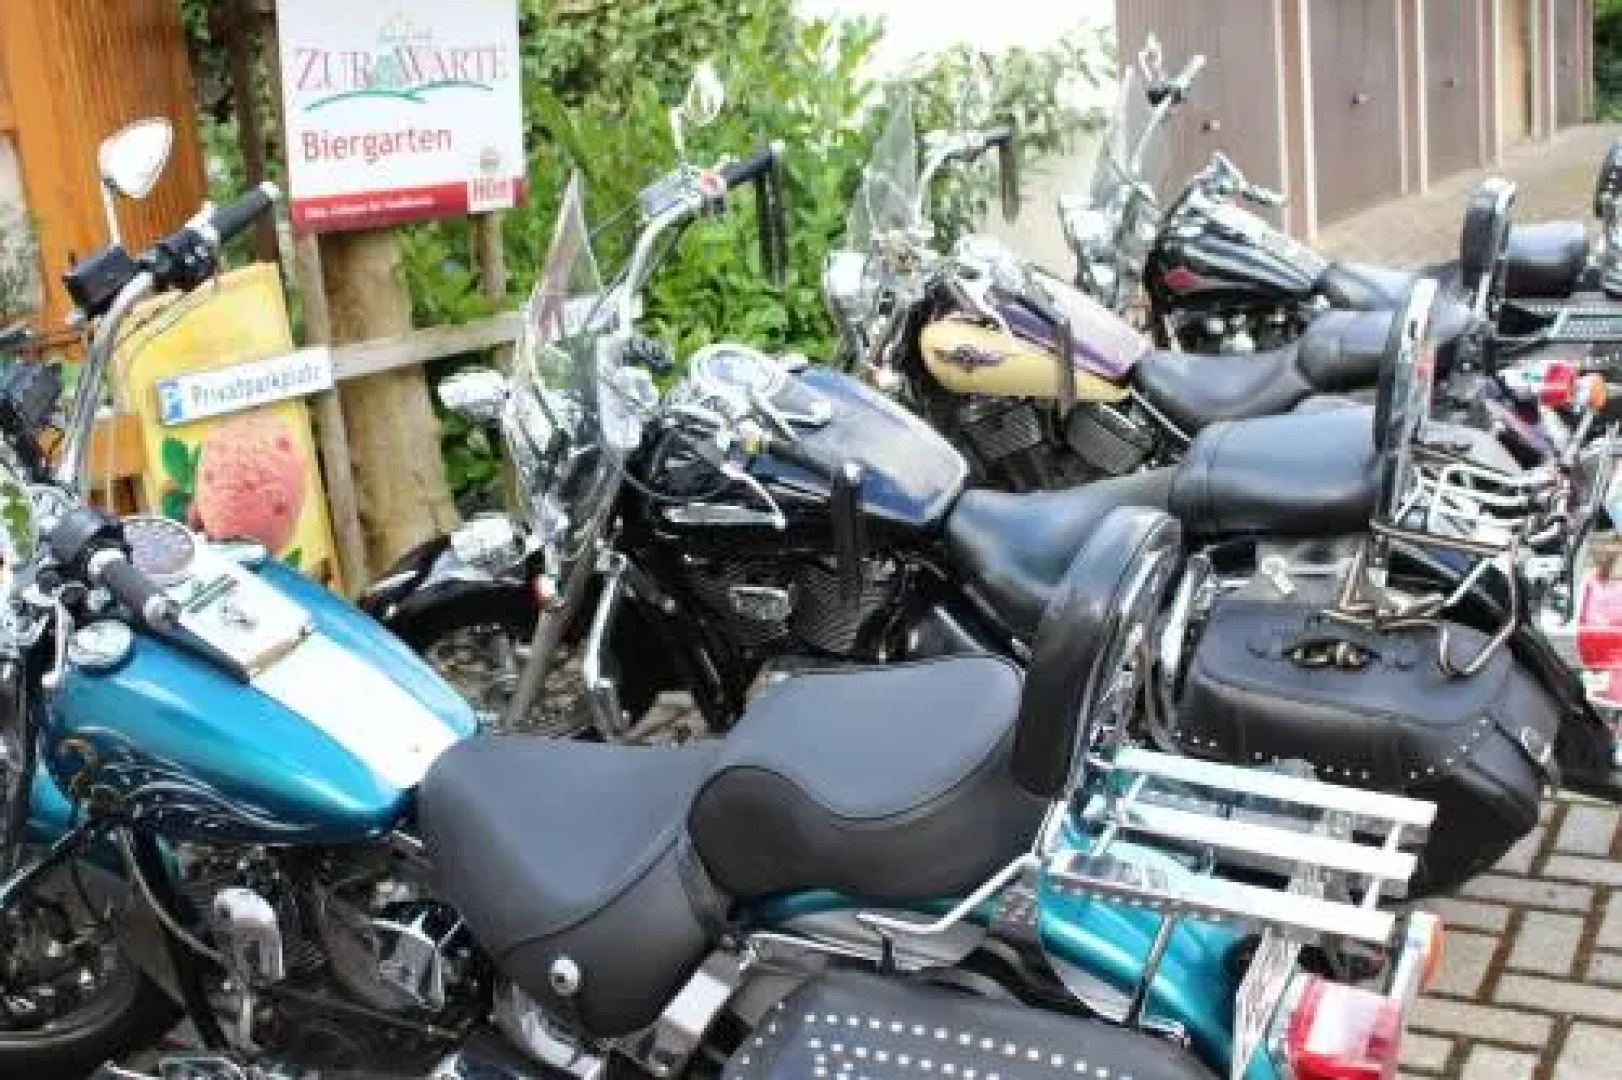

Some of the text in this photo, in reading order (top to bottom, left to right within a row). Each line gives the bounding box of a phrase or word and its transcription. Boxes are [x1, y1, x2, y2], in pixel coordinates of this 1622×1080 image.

[296, 43, 509, 91] ZUR WARTE
[301, 128, 452, 164] Biergarten
